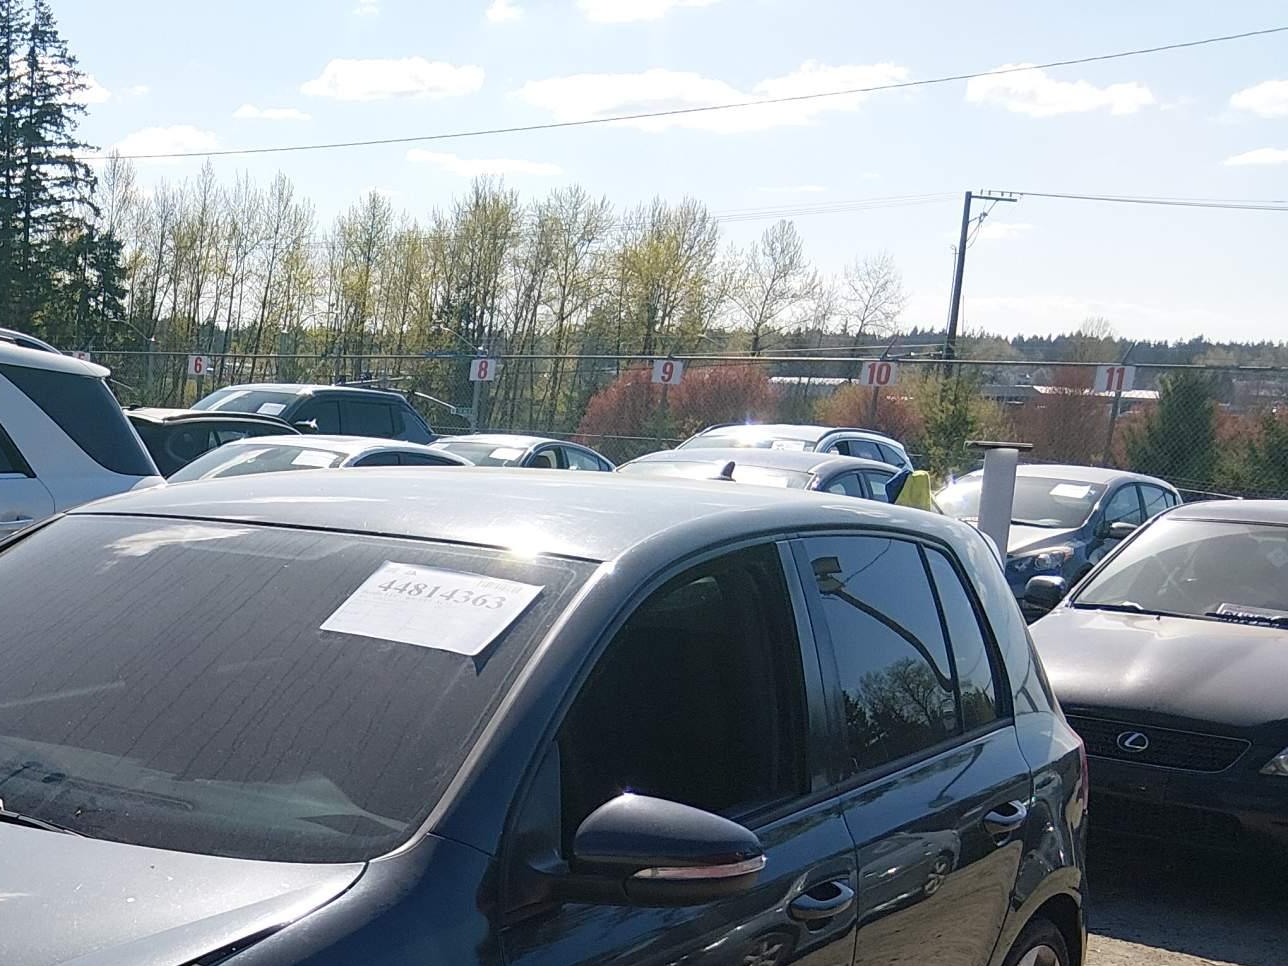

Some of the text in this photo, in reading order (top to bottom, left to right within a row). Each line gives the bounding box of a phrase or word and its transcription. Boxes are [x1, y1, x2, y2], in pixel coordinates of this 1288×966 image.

[194, 356, 202, 373] 6
[478, 360, 489, 379] 8
[661, 362, 674, 382] 9
[867, 362, 891, 385] 10
[1105, 367, 1126, 391] 11
[378, 579, 506, 609] 44814363
